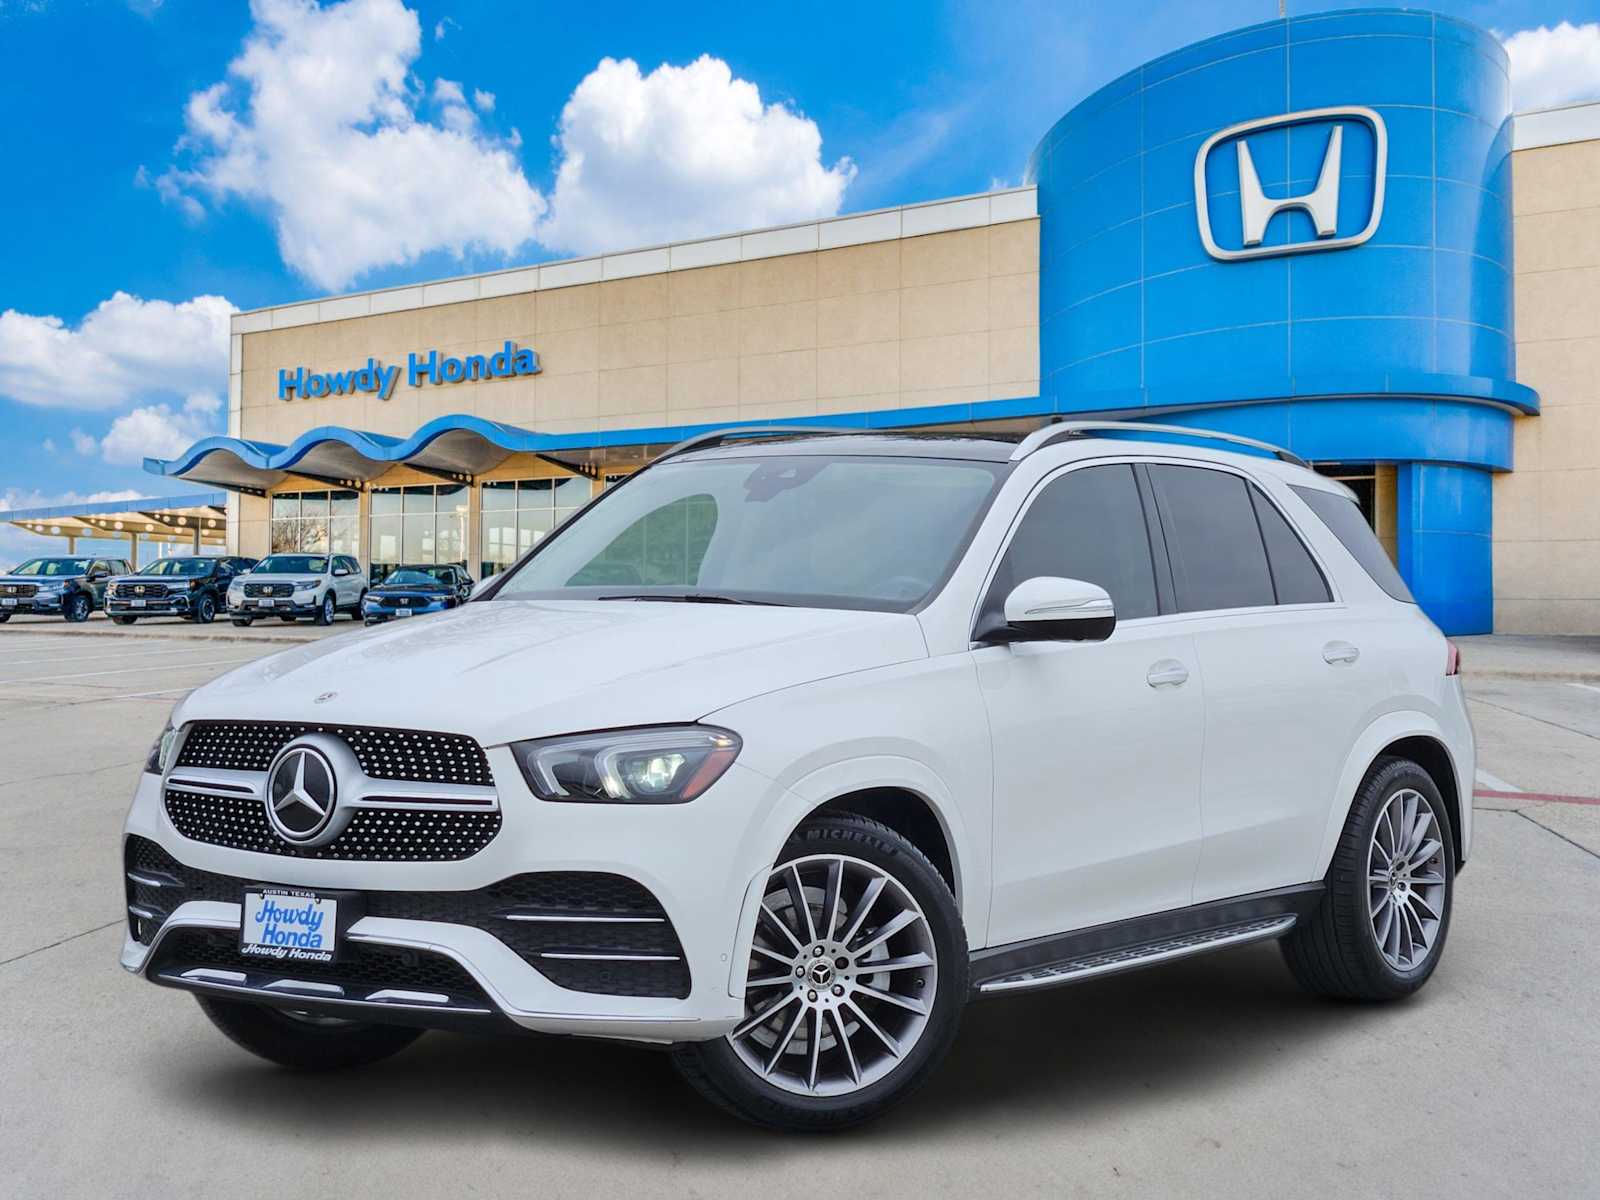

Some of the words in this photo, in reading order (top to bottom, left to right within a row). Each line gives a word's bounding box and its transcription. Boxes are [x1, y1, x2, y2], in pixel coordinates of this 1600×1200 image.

[279, 357, 401, 401] Howdy
[408, 340, 541, 388] Honda
[807, 829, 897, 855] MICHELIN
[255, 900, 324, 932] Howdy
[261, 922, 323, 948] Honda
[241, 943, 288, 959] Howdy
[288, 948, 332, 961] Honda
